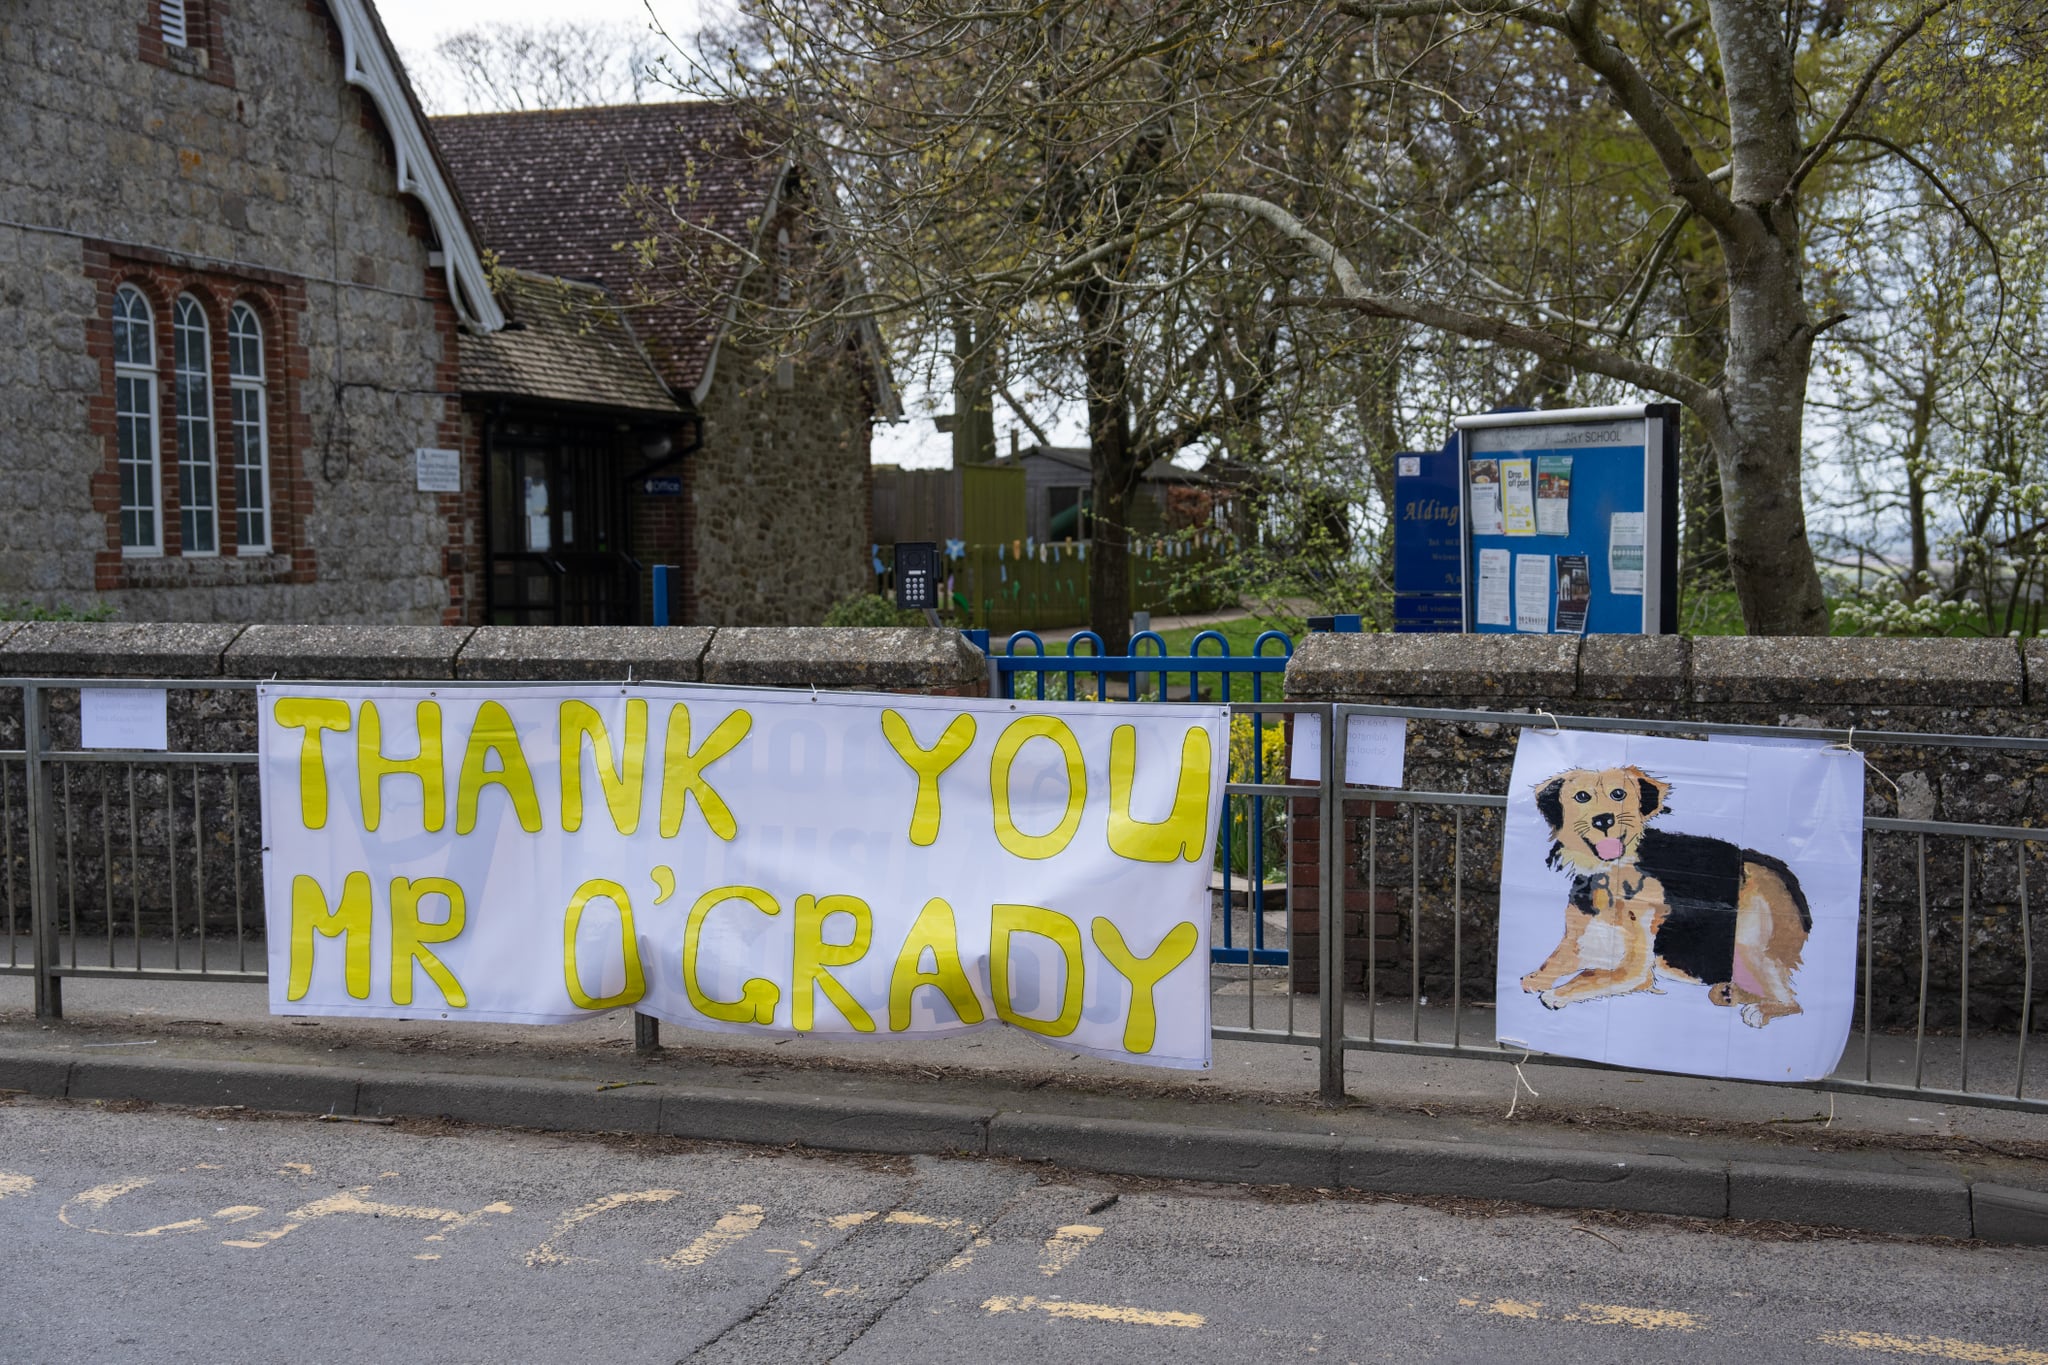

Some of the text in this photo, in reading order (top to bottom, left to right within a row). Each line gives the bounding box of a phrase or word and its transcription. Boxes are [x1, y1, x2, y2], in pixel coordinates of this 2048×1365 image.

[1585, 430, 1621, 442] SCHOOL
[1508, 470, 1522, 479] Drop
[653, 480, 680, 492] Office
[1508, 479, 1529, 488] off point
[273, 697, 753, 842] THANK
[881, 708, 1212, 864] YOU
[287, 870, 468, 1009] MR
[563, 865, 1199, 1054] O'GRADY
